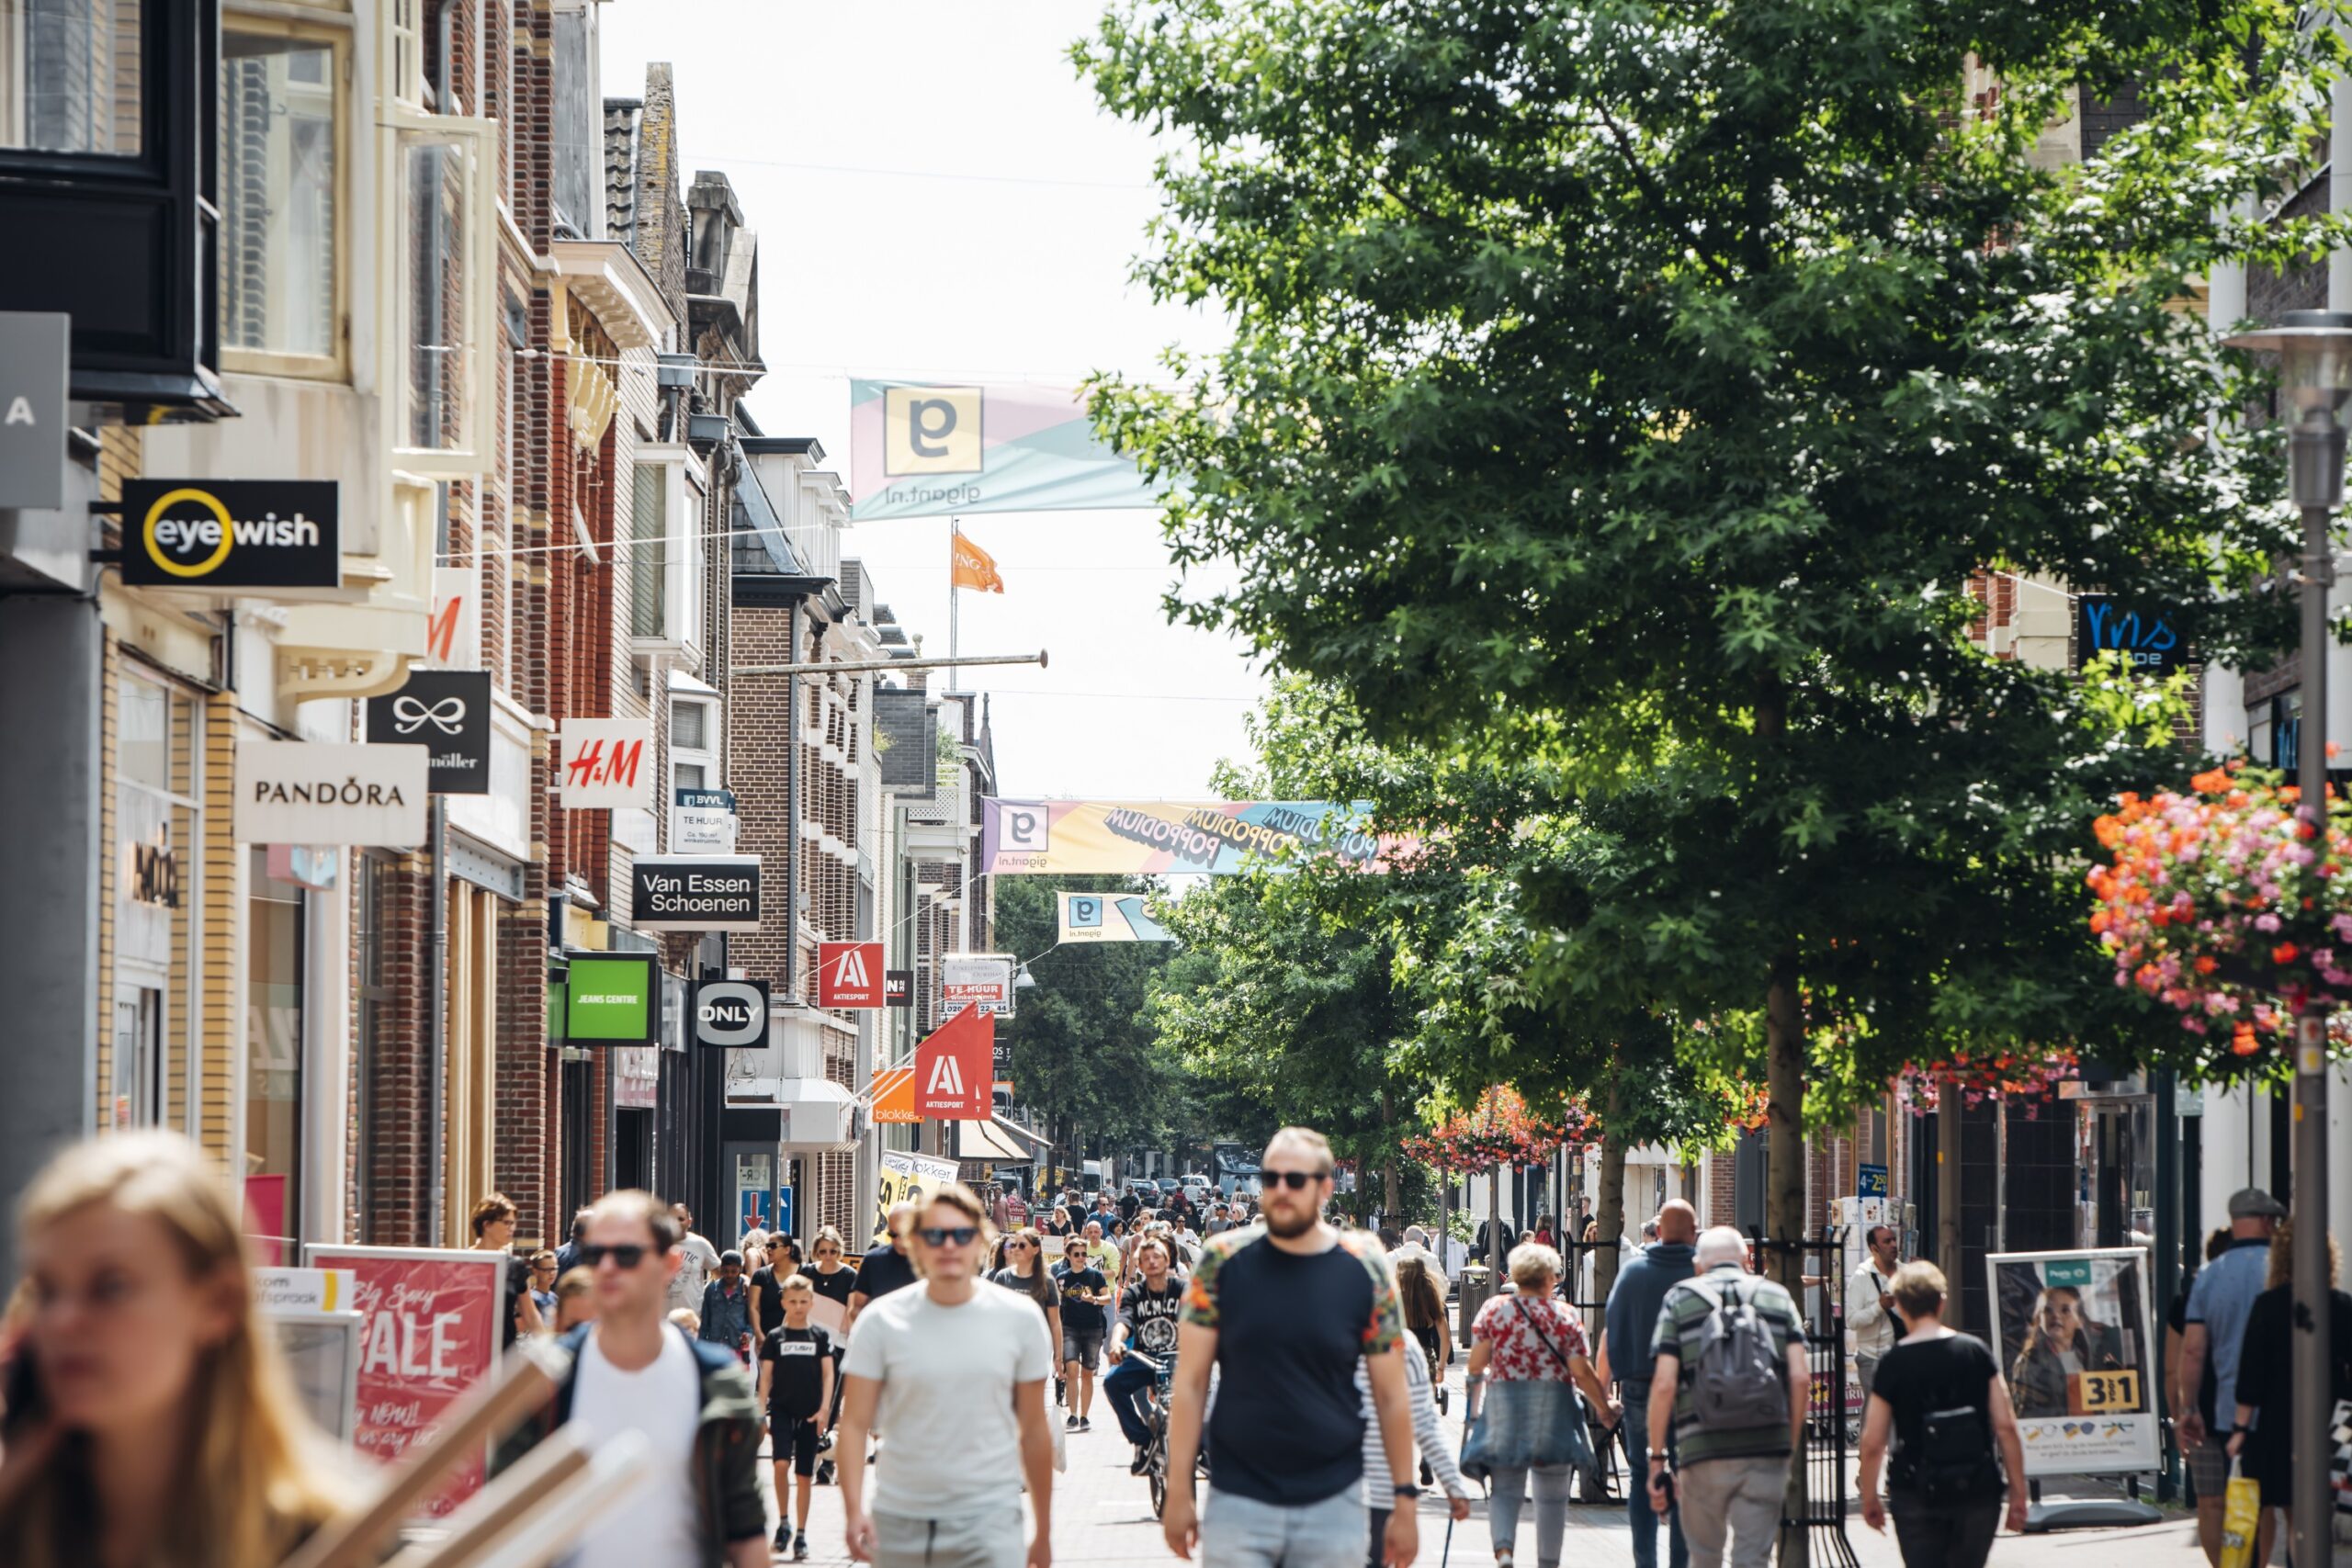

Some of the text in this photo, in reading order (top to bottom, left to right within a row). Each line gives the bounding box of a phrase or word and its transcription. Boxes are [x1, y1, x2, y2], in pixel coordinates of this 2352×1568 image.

[153, 512, 320, 554] eyewish
[567, 739, 644, 788] H&M
[254, 777, 404, 808] PANDORA
[684, 816, 722, 825] TE HUUR
[642, 874, 751, 893] Van Essen
[650, 893, 751, 912] Schoenen
[967, 985, 999, 993] HUUR
[578, 995, 639, 1004] JEANS CENTRE
[697, 1005, 761, 1023] ONLY
[925, 1100, 964, 1109] AKTIESPORT
[356, 1310, 463, 1378] ALE
